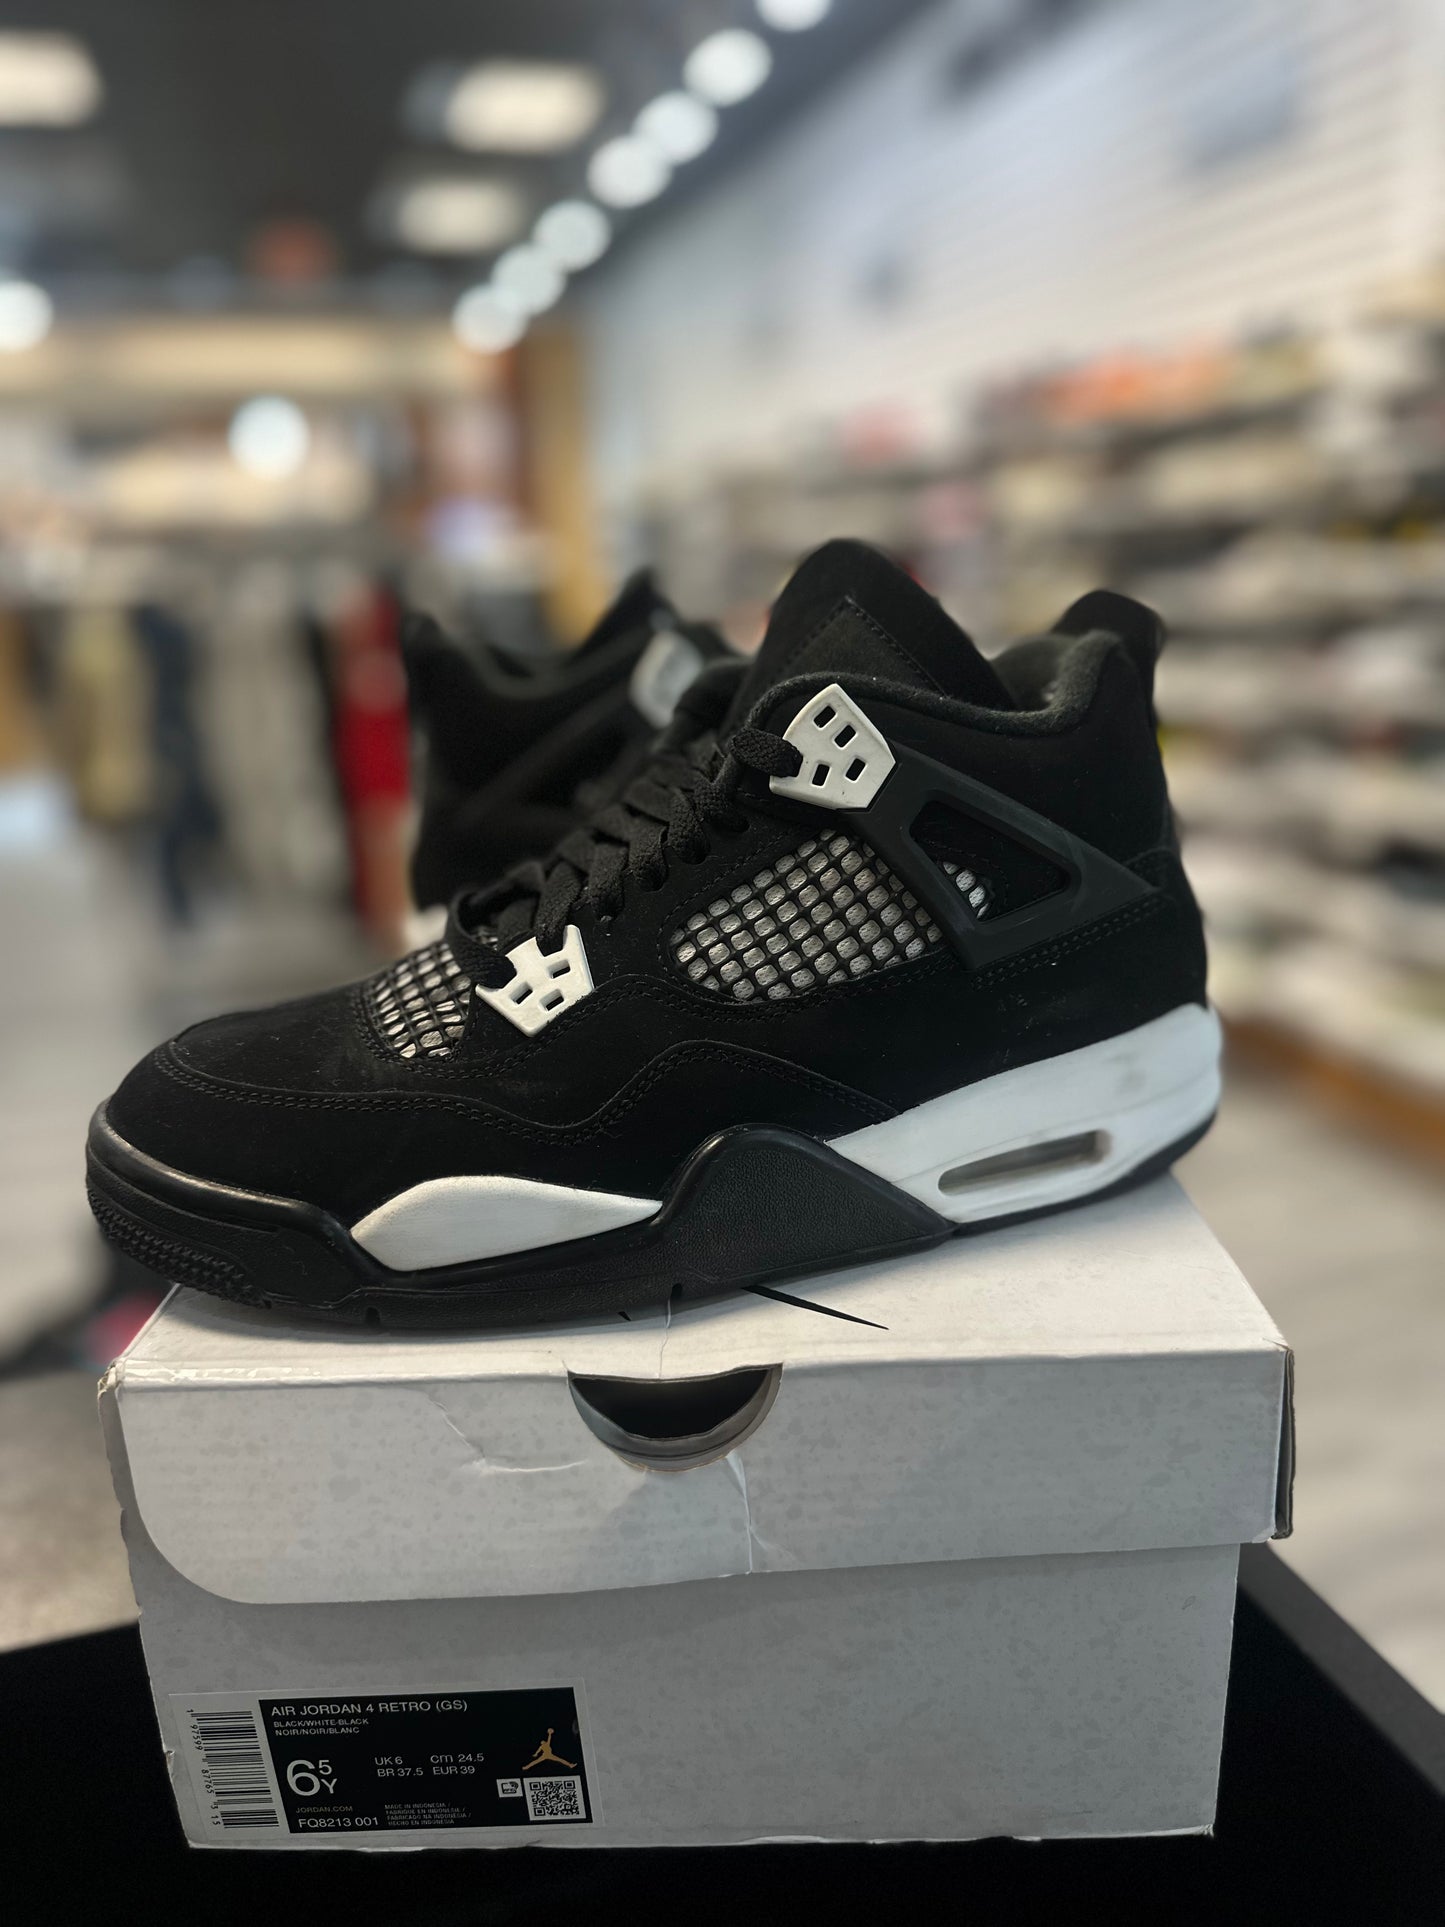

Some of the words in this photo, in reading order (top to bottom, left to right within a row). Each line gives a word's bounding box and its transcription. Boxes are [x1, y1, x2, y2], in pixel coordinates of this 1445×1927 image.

[271, 1705, 296, 1716] AIR
[300, 1703, 362, 1716] JORDAN
[366, 1703, 375, 1713] 4
[379, 1701, 431, 1713] RETRO
[435, 1700, 468, 1712] (GS)
[275, 1727, 360, 1736] NOIR/NOIR/BLANC
[190, 1724, 203, 1751] 97599
[201, 1769, 215, 1794] 87765
[375, 1756, 393, 1766] UK
[394, 1756, 403, 1765] 6
[458, 1753, 485, 1763] 24.5
[286, 1759, 321, 1796] 6
[377, 1768, 396, 1777] BR
[397, 1767, 424, 1777] 37.5
[432, 1766, 458, 1776] EUR
[459, 1765, 476, 1775] 39
[320, 1778, 338, 1794] Y
[296, 1805, 353, 1814] JORDAN.COM
[298, 1817, 352, 1829] FQ8213
[354, 1816, 379, 1827] 001
